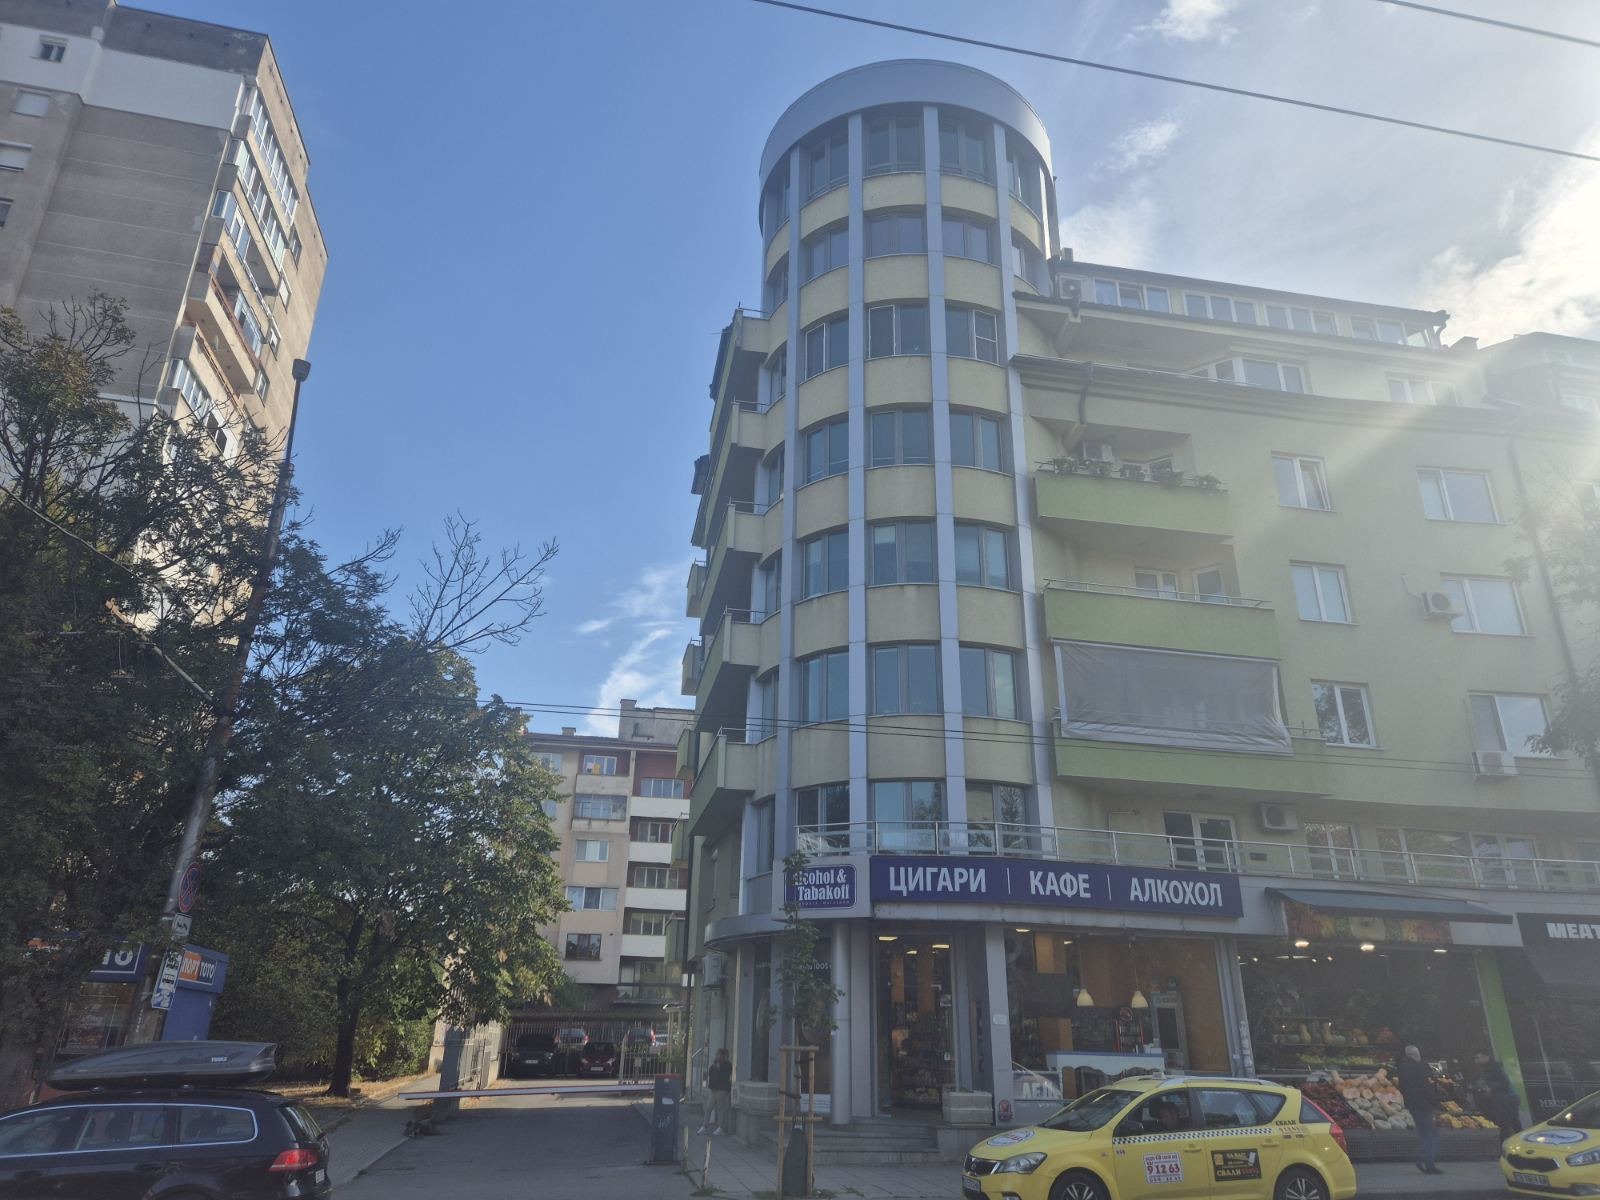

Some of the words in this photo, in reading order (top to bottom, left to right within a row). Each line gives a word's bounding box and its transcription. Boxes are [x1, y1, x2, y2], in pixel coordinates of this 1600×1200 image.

[837, 868, 847, 883] &
[797, 884, 849, 900] Tabakoff
[889, 866, 987, 897] ЦИГАРИ
[1029, 870, 1092, 899] КАФЕ
[1129, 877, 1223, 907] АЛКОХОЛ
